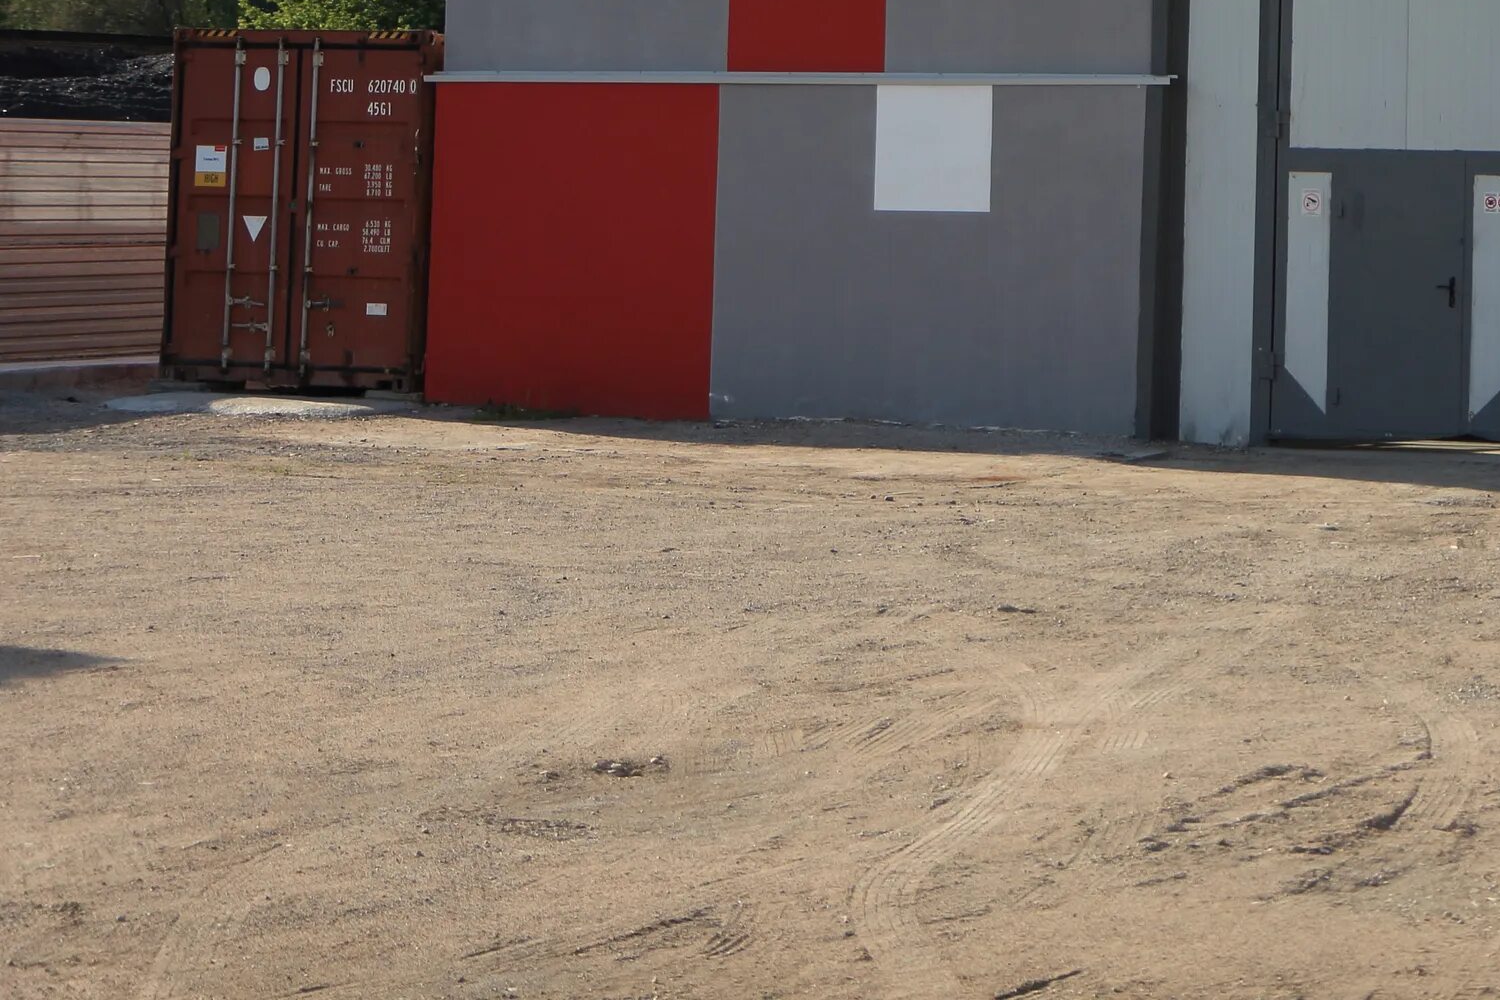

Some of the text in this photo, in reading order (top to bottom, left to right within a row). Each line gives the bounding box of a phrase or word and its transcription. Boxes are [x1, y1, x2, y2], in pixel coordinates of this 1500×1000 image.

[330, 79, 354, 93] FSCU
[367, 79, 406, 94] 620740
[367, 101, 392, 116] 45G1
[335, 167, 352, 175] GROSS
